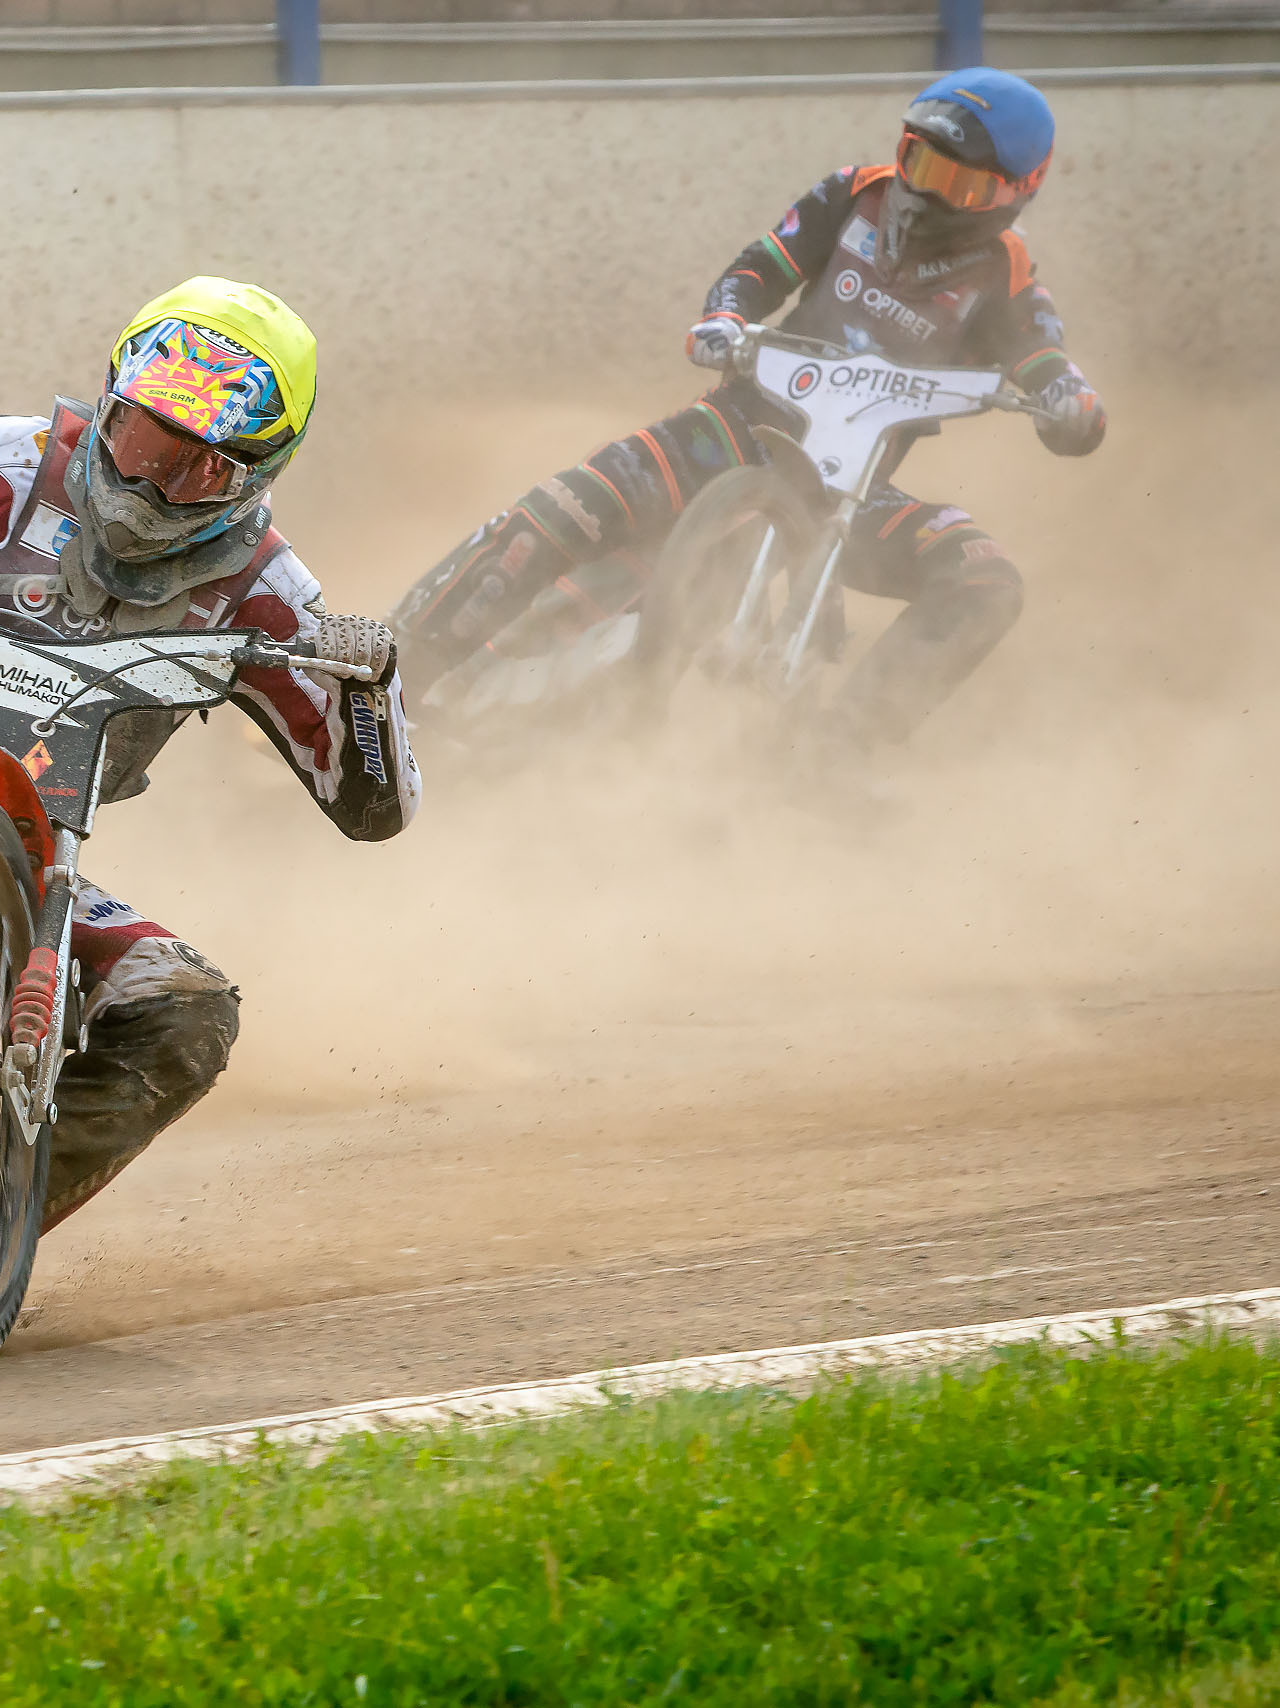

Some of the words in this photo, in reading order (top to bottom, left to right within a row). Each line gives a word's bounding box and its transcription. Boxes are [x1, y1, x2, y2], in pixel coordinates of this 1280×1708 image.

[863, 287, 937, 341] OPTIBET
[170, 391, 197, 405] BAM
[829, 366, 941, 403] OPTIBET
